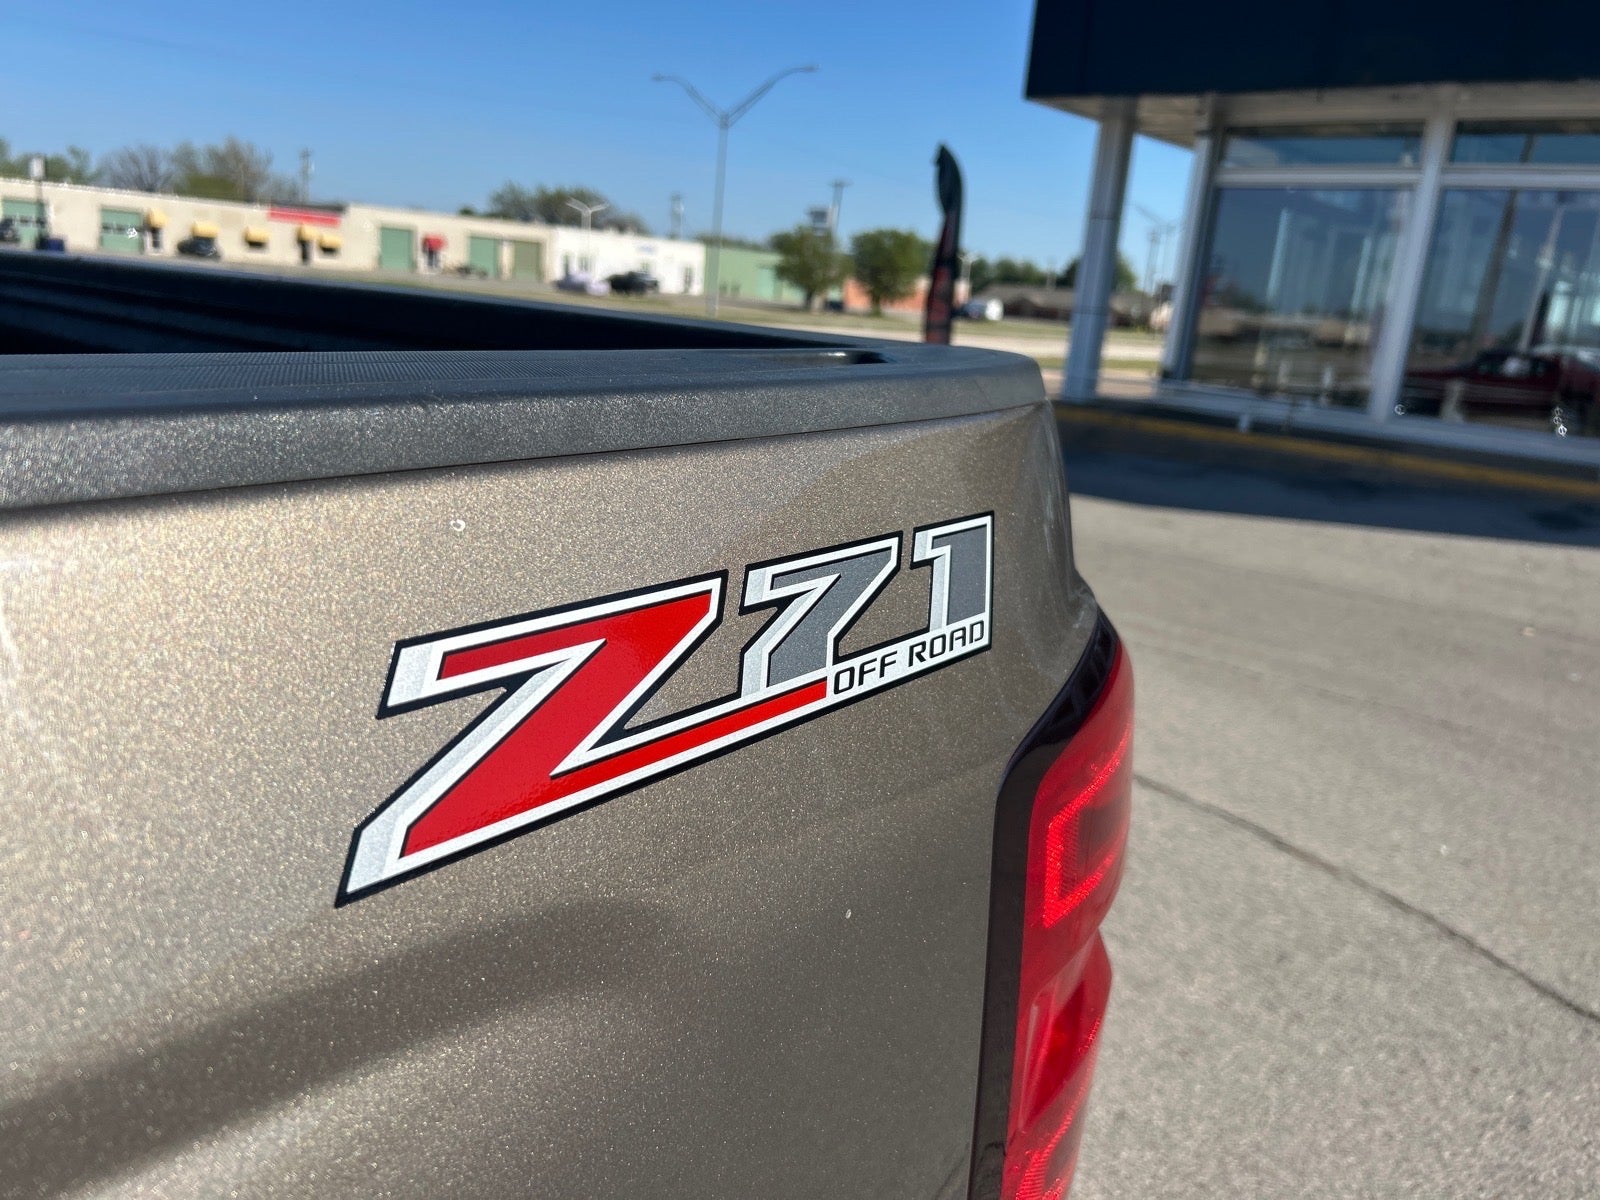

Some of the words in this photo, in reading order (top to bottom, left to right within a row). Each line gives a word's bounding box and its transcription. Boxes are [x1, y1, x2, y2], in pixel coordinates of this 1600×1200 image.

[336, 511, 994, 907] Z71
[833, 650, 898, 695] OFF
[908, 620, 984, 667] ROAD
